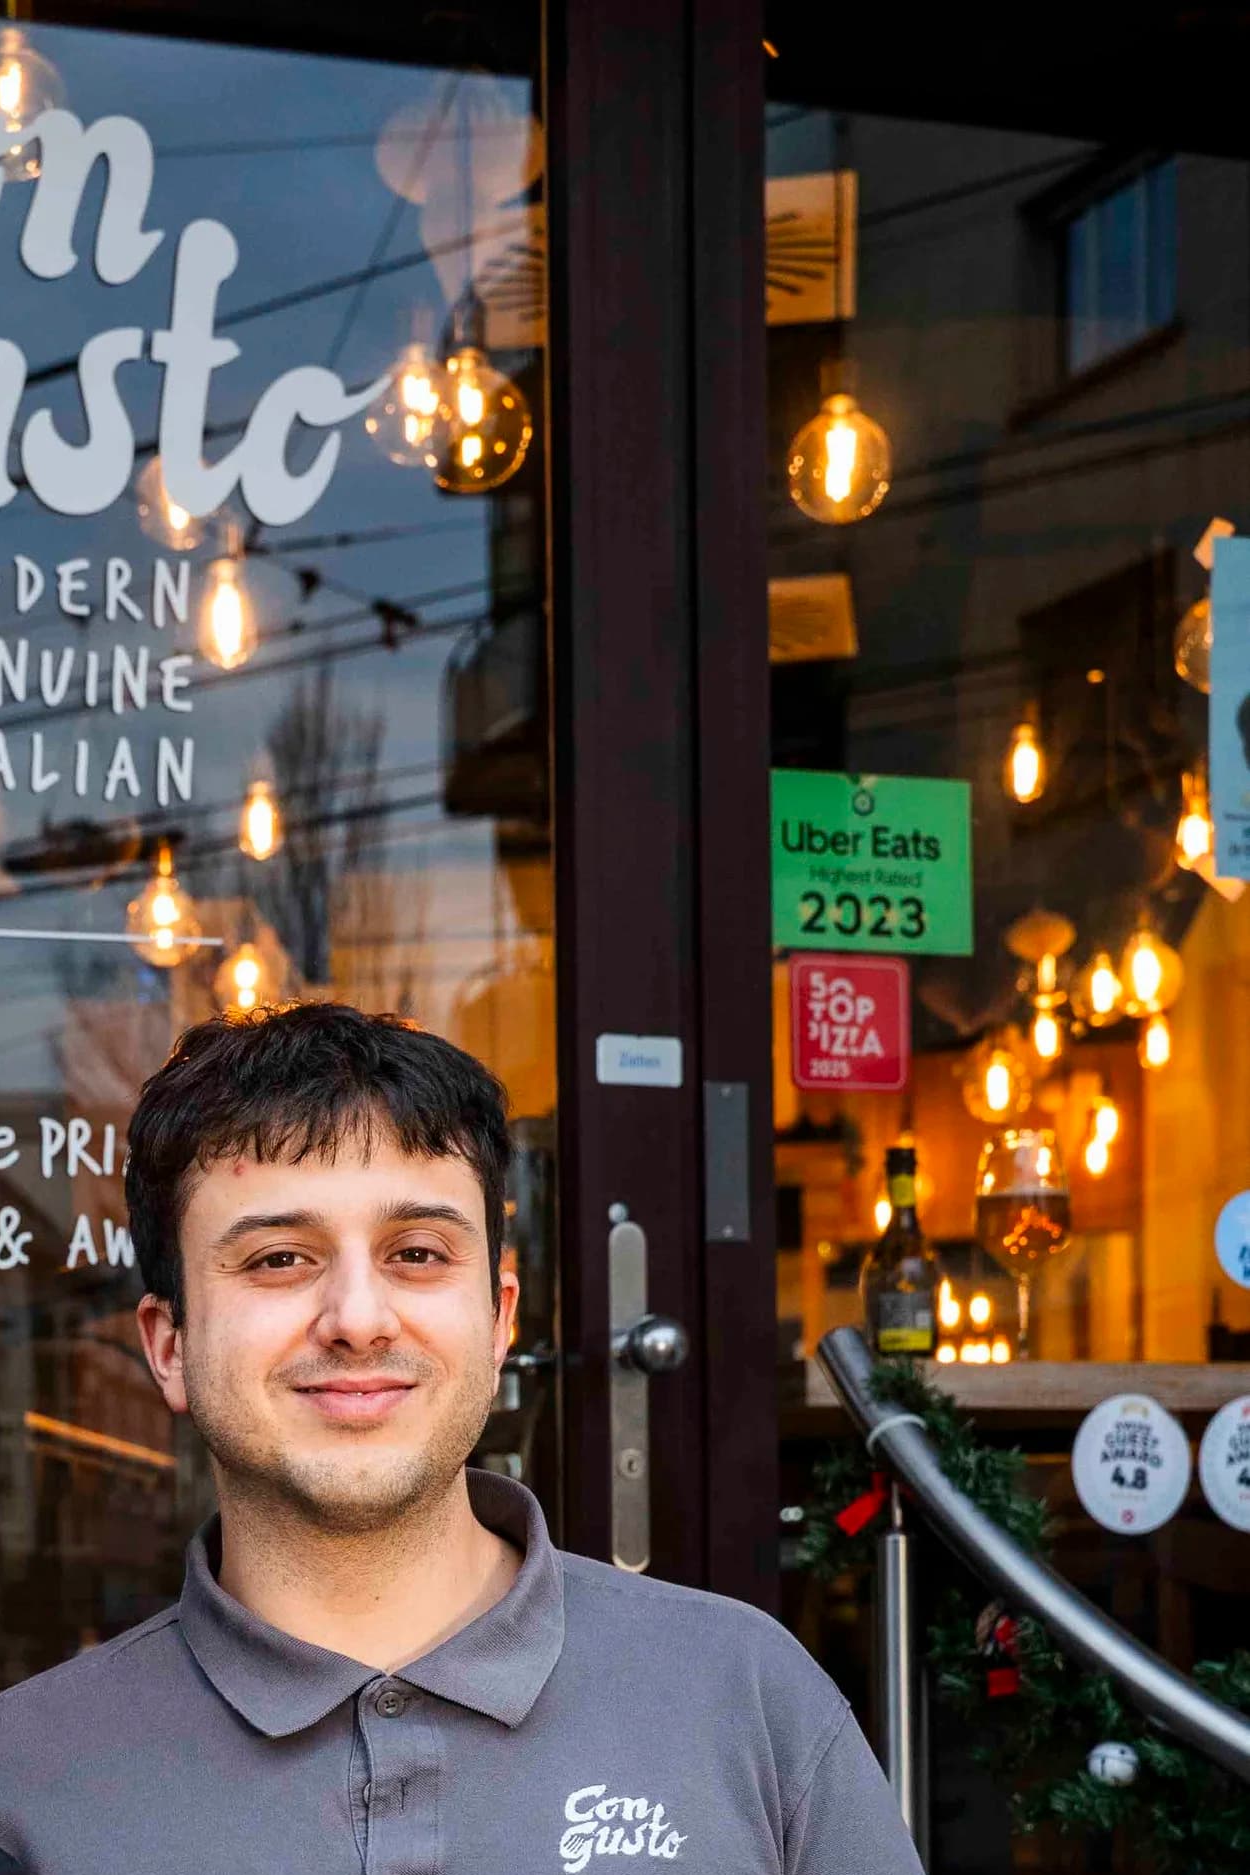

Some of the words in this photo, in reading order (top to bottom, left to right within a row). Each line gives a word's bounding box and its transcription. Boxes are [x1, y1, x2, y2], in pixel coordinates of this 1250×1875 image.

[781, 818, 864, 858] Uber
[871, 825, 942, 862] Eats
[800, 890, 928, 939] 2023
[808, 994, 875, 1025] TOP
[39, 1116, 130, 1179] PRI
[65, 1213, 136, 1270] AW
[1111, 1465, 1148, 1490] 4.8
[564, 1784, 653, 1822] Con
[559, 1803, 689, 1874] Gusto
